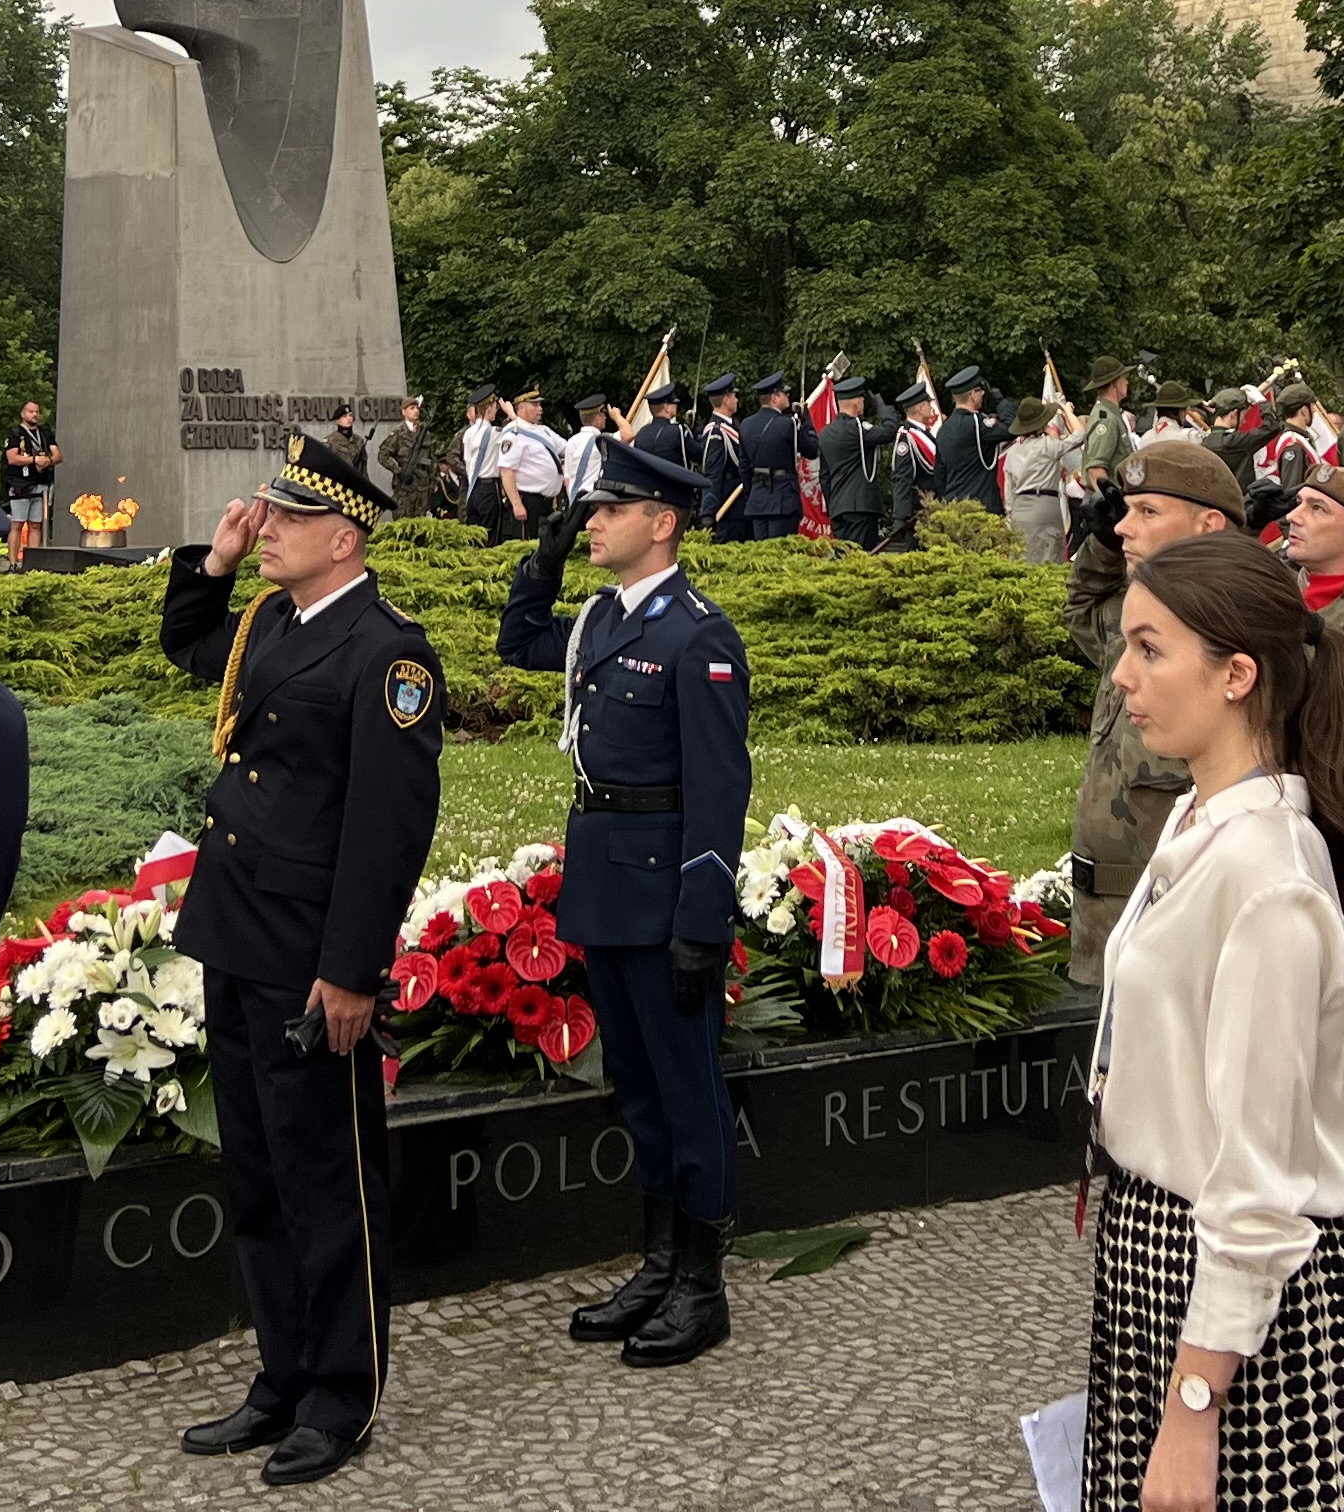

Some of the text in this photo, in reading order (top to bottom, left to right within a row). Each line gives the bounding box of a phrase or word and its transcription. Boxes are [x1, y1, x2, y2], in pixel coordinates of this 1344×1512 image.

[179, 367, 244, 394] O BOGA
[178, 394, 203, 422] ZA
[180, 423, 260, 450] CZERWIEC
